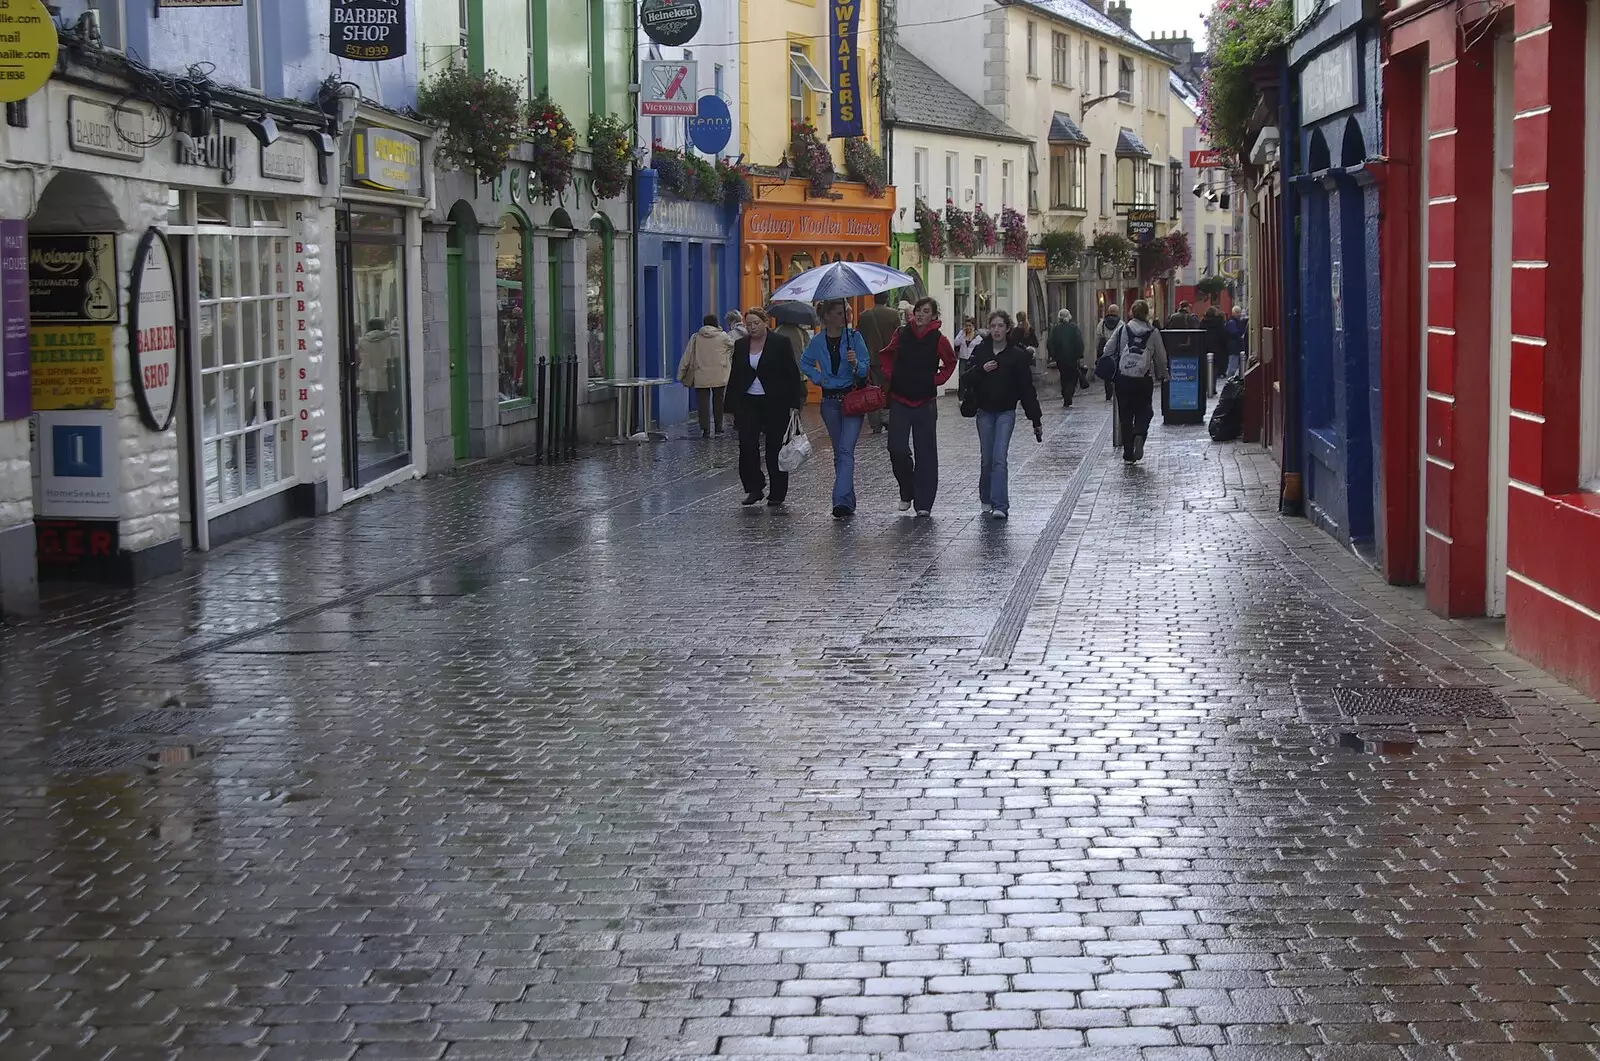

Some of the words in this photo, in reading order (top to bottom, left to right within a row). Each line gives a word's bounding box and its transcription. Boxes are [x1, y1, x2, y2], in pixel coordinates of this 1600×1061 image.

[334, 8, 399, 24] BARBER
[648, 7, 693, 22] Heineken
[343, 25, 390, 41] SHOP
[345, 44, 362, 56] EST.
[365, 45, 389, 57] 1939
[645, 103, 693, 113] VICTORINOX
[76, 119, 113, 149] BARBER
[750, 213, 795, 240] Galway
[799, 215, 841, 236] Woollen
[845, 217, 881, 237] Market
[5, 235, 24, 249] MALT
[3, 256, 27, 270] HOUSE
[136, 325, 176, 354] BARBER
[144, 362, 171, 390] SHOP
